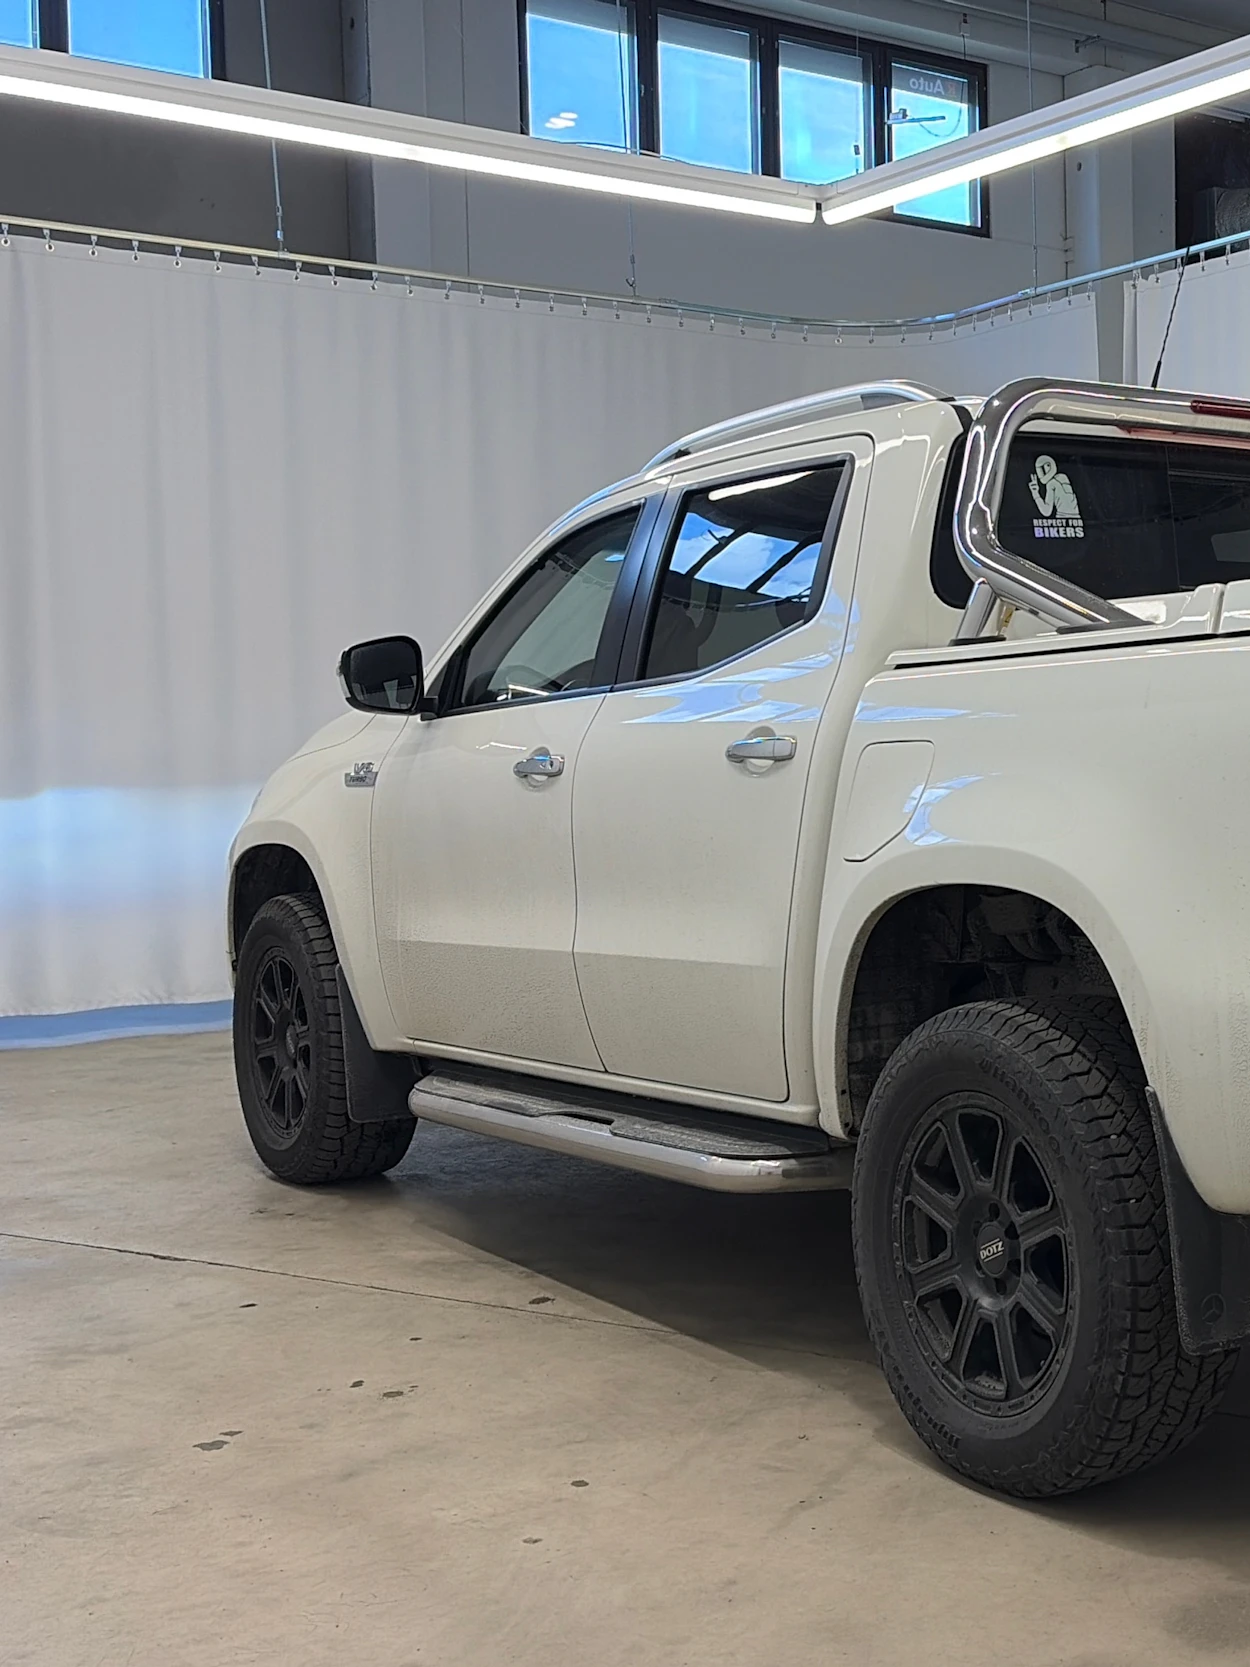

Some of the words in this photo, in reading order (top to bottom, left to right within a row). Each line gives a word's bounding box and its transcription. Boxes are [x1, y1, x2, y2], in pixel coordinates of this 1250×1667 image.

[1033, 519, 1066, 527] RESPECT
[1069, 519, 1083, 527] FOR
[1034, 527, 1084, 537] BIKERS
[980, 1241, 1004, 1260] DOTZ
